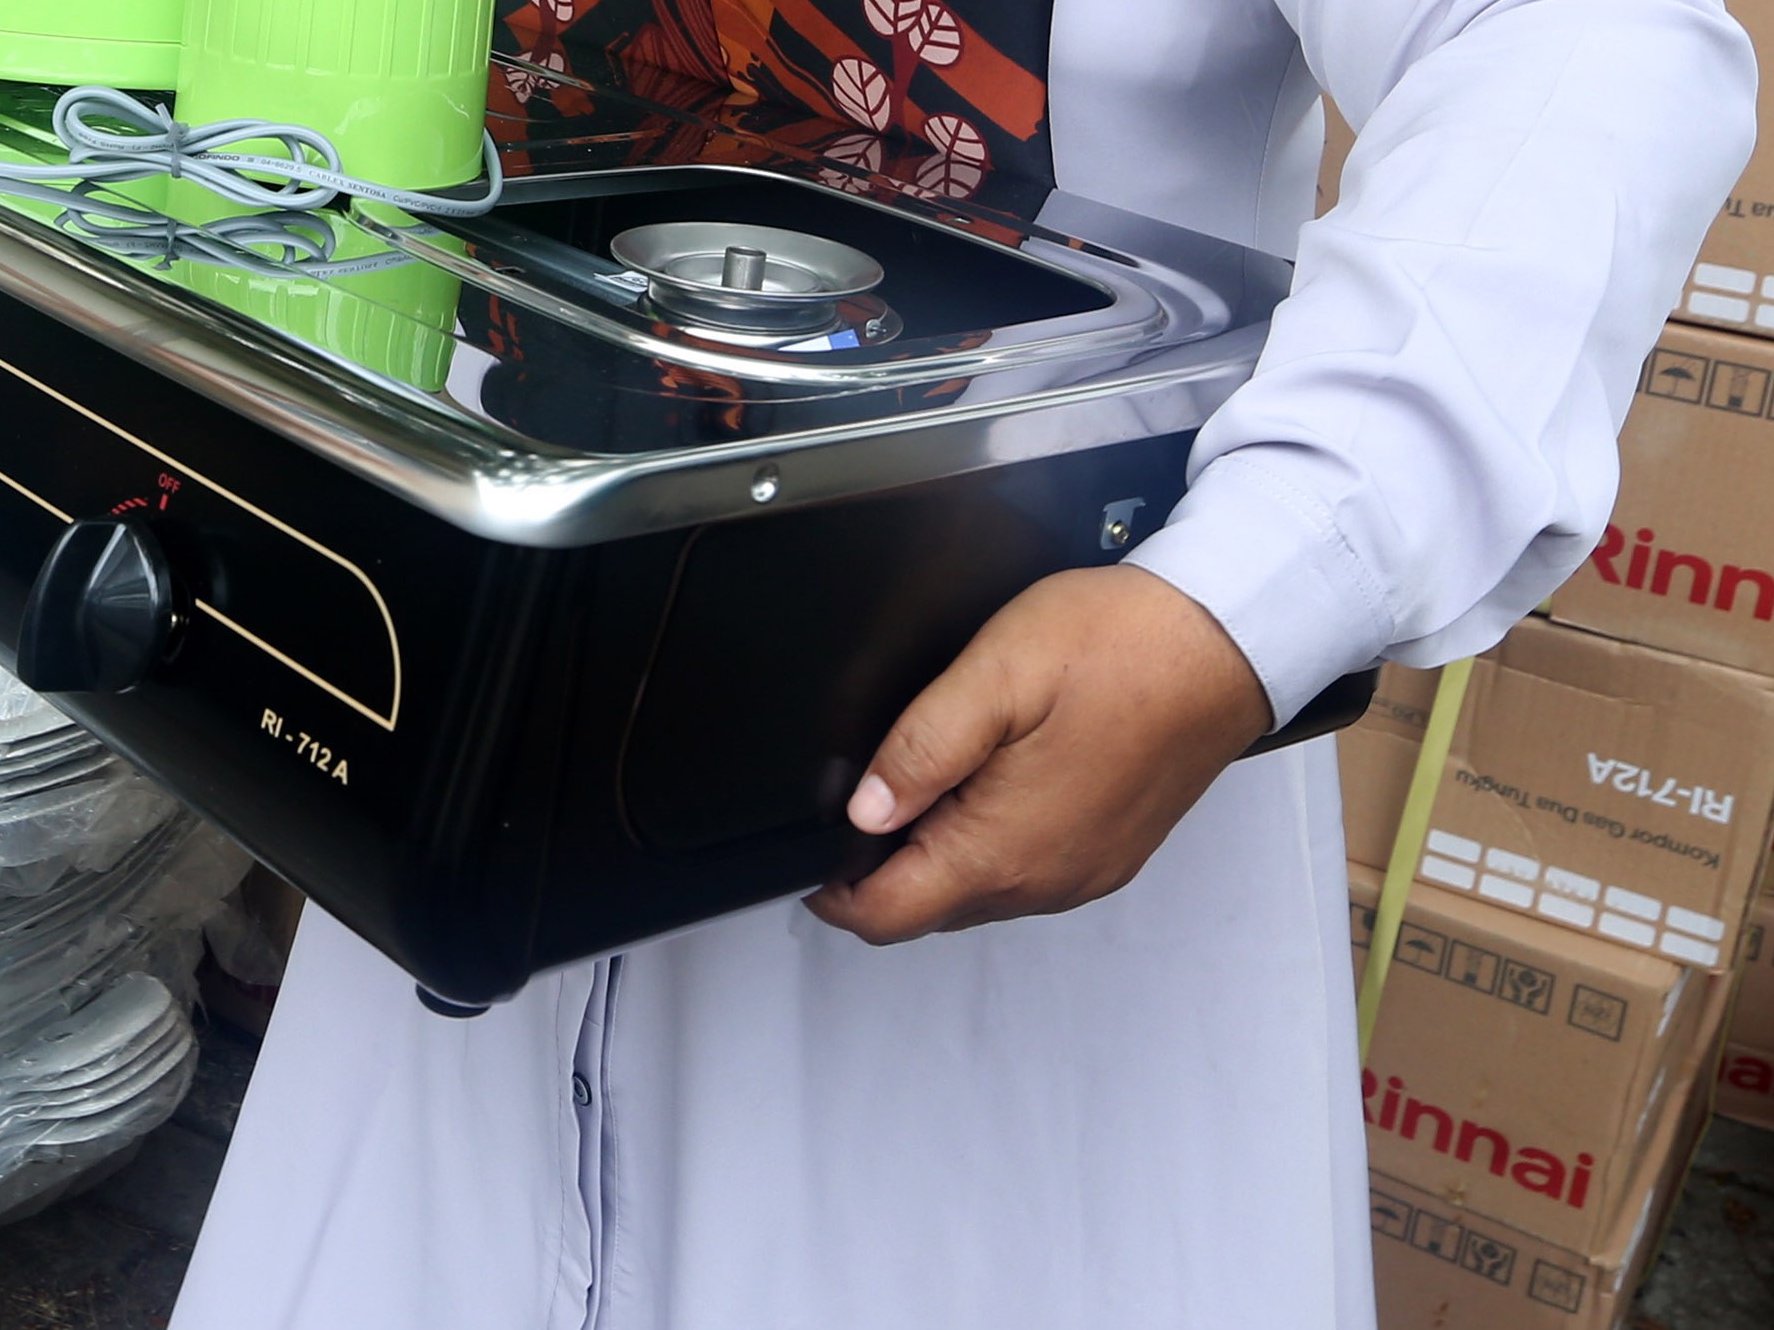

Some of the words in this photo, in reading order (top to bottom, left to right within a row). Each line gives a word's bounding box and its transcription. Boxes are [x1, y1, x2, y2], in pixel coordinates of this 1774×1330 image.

[308, 169, 345, 188] CABLEX
[347, 181, 387, 199] SENTOSA
[158, 473, 182, 495] OFF
[1455, 768, 1530, 810] Tungku
[1586, 752, 1734, 824] RI-712A
[1537, 795, 1579, 824] Dua
[1583, 808, 1626, 839] Gas
[1629, 827, 1721, 869] Kompor
